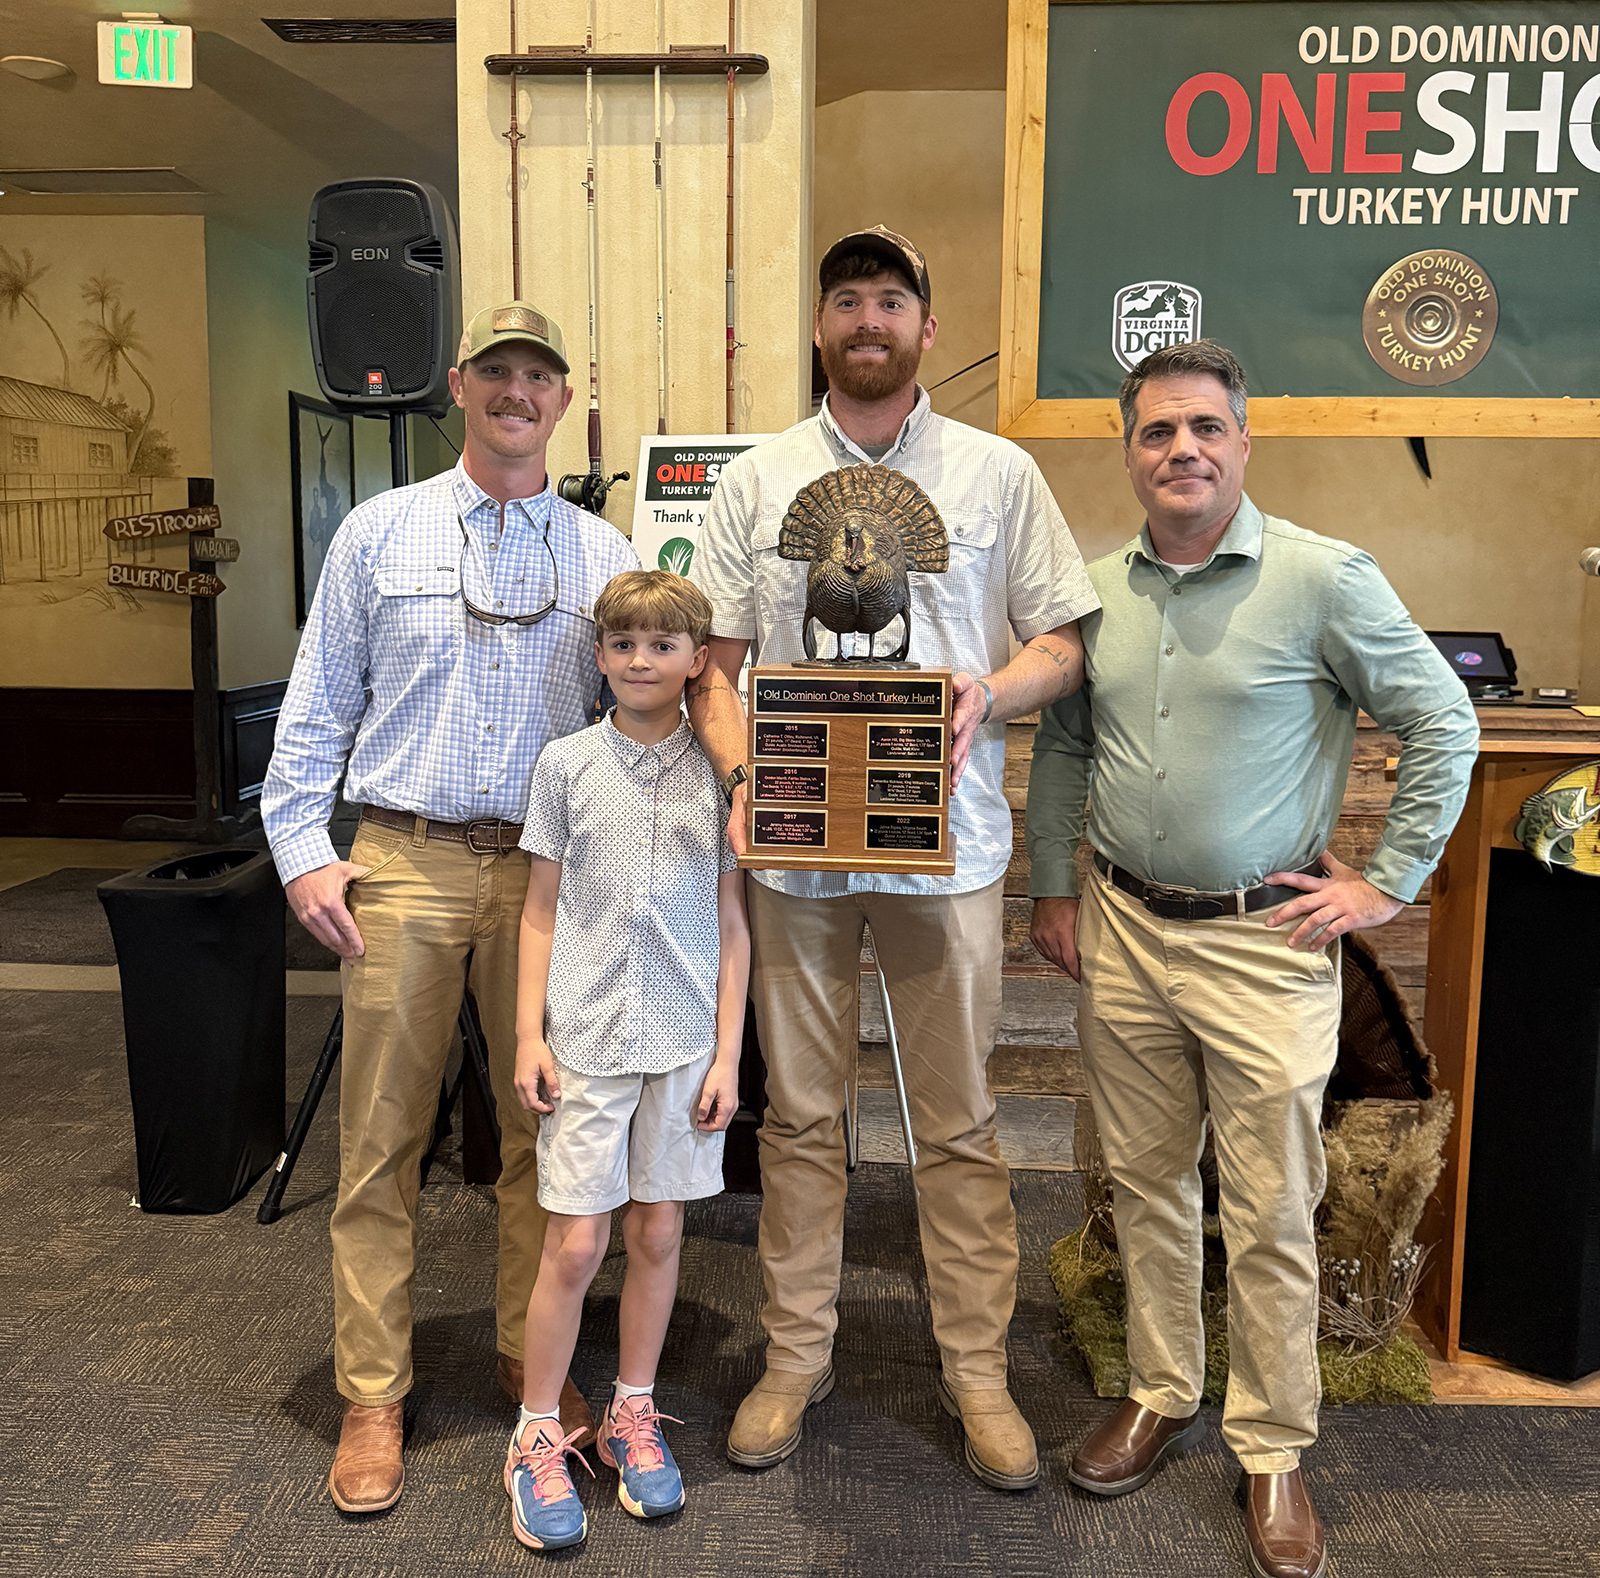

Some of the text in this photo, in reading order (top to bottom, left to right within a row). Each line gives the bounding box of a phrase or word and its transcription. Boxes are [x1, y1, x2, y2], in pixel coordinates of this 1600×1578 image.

[114, 27, 180, 82] EXIT
[1299, 25, 1598, 63] OLD DOMINION
[1293, 188, 1578, 224] TURKEY HUNT
[352, 248, 389, 260] EON
[1378, 256, 1490, 302] OLD DOMINION
[1394, 272, 1473, 303] ONE SHOT
[1125, 321, 1188, 329] VIRGINIA
[1377, 323, 1482, 372] TURKEY HUNT
[674, 453, 695, 462] OLD
[661, 486, 700, 495] TURKEY
[114, 514, 219, 538] RESTROOMS
[653, 509, 693, 522] Thank
[764, 690, 935, 704] Old Dominion One Shot Turkey Hunt
